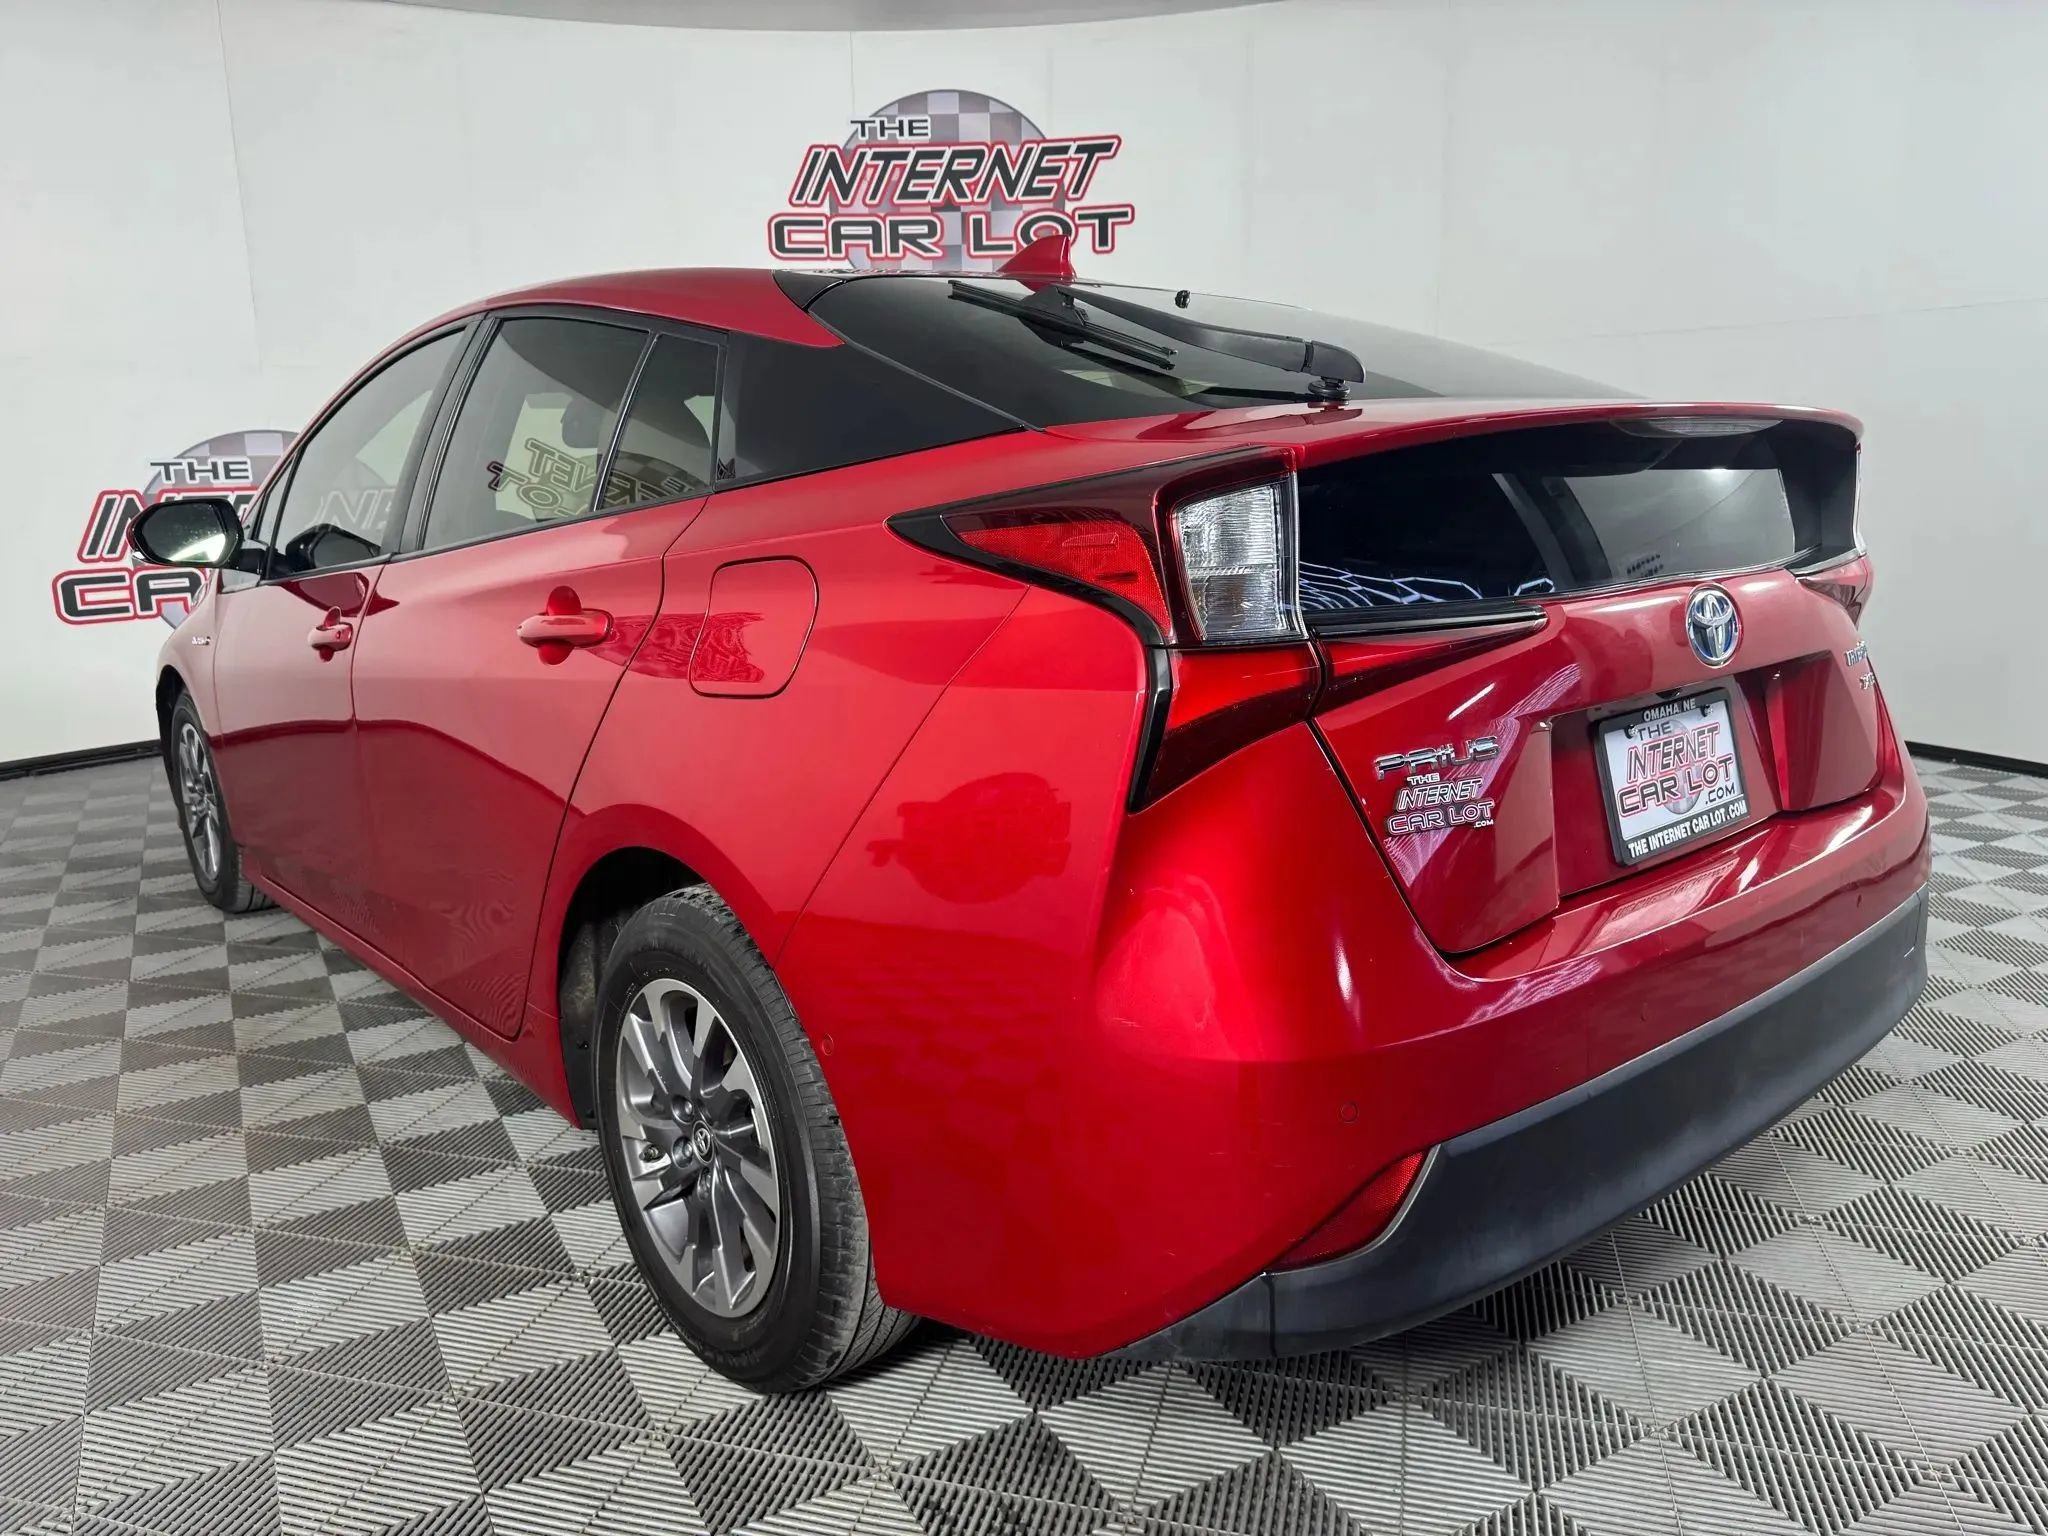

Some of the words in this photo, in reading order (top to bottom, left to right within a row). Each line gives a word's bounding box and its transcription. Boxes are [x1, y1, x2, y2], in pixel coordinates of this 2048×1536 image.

[851, 119, 930, 138] THE
[793, 139, 1119, 203] INTERNET
[772, 217, 942, 257] CAR
[971, 209, 1132, 254] LOT
[150, 461, 249, 481] THE
[63, 571, 199, 618] CA
[1637, 721, 1672, 741] THE
[1628, 724, 1719, 782] INTERNET
[1397, 778, 1482, 811] INTERNET
[1407, 773, 1440, 785] THE
[1617, 775, 1680, 815] CAR
[1687, 756, 1733, 792] LOT
[1705, 784, 1736, 805] .COM
[1388, 812, 1445, 834] CAR
[1449, 802, 1494, 824] LOT
[1474, 820, 1494, 829] .COM
[1628, 838, 1649, 858] THE
[1648, 821, 1691, 851] INTERNET
[1692, 814, 1710, 834] CAR
